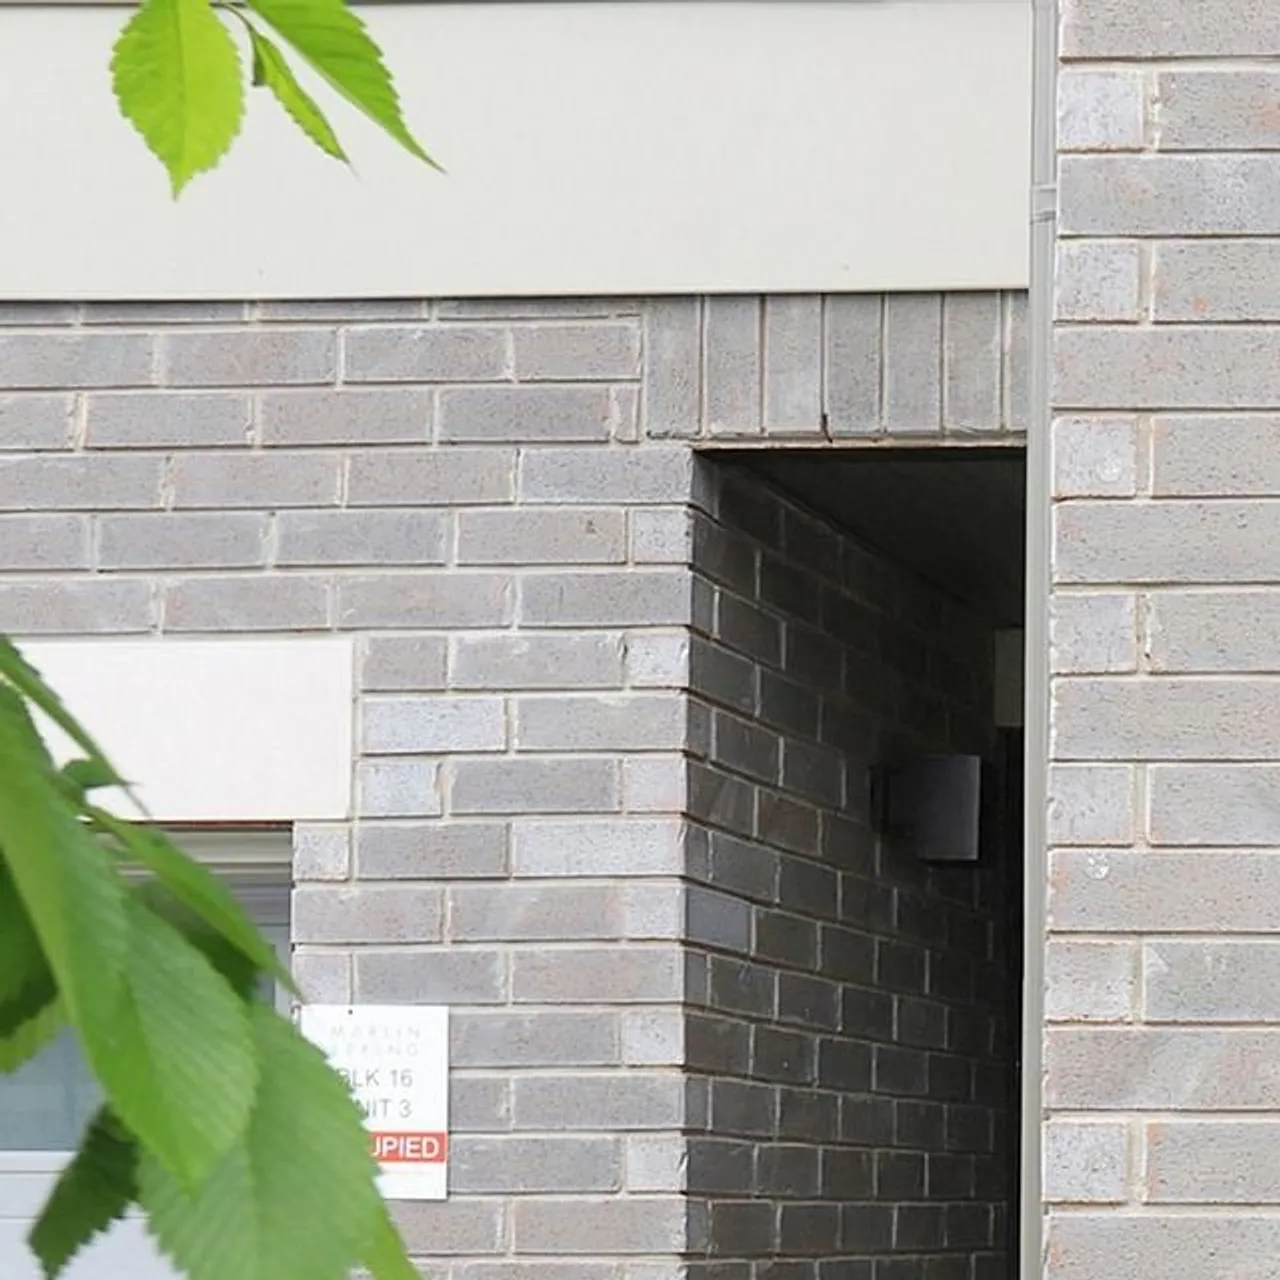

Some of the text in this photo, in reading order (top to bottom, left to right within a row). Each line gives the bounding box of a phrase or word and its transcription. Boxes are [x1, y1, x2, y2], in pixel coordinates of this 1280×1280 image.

[389, 1067, 414, 1089] 16
[352, 1098, 413, 1119] NIT 3
[370, 1135, 440, 1159] UPIED
